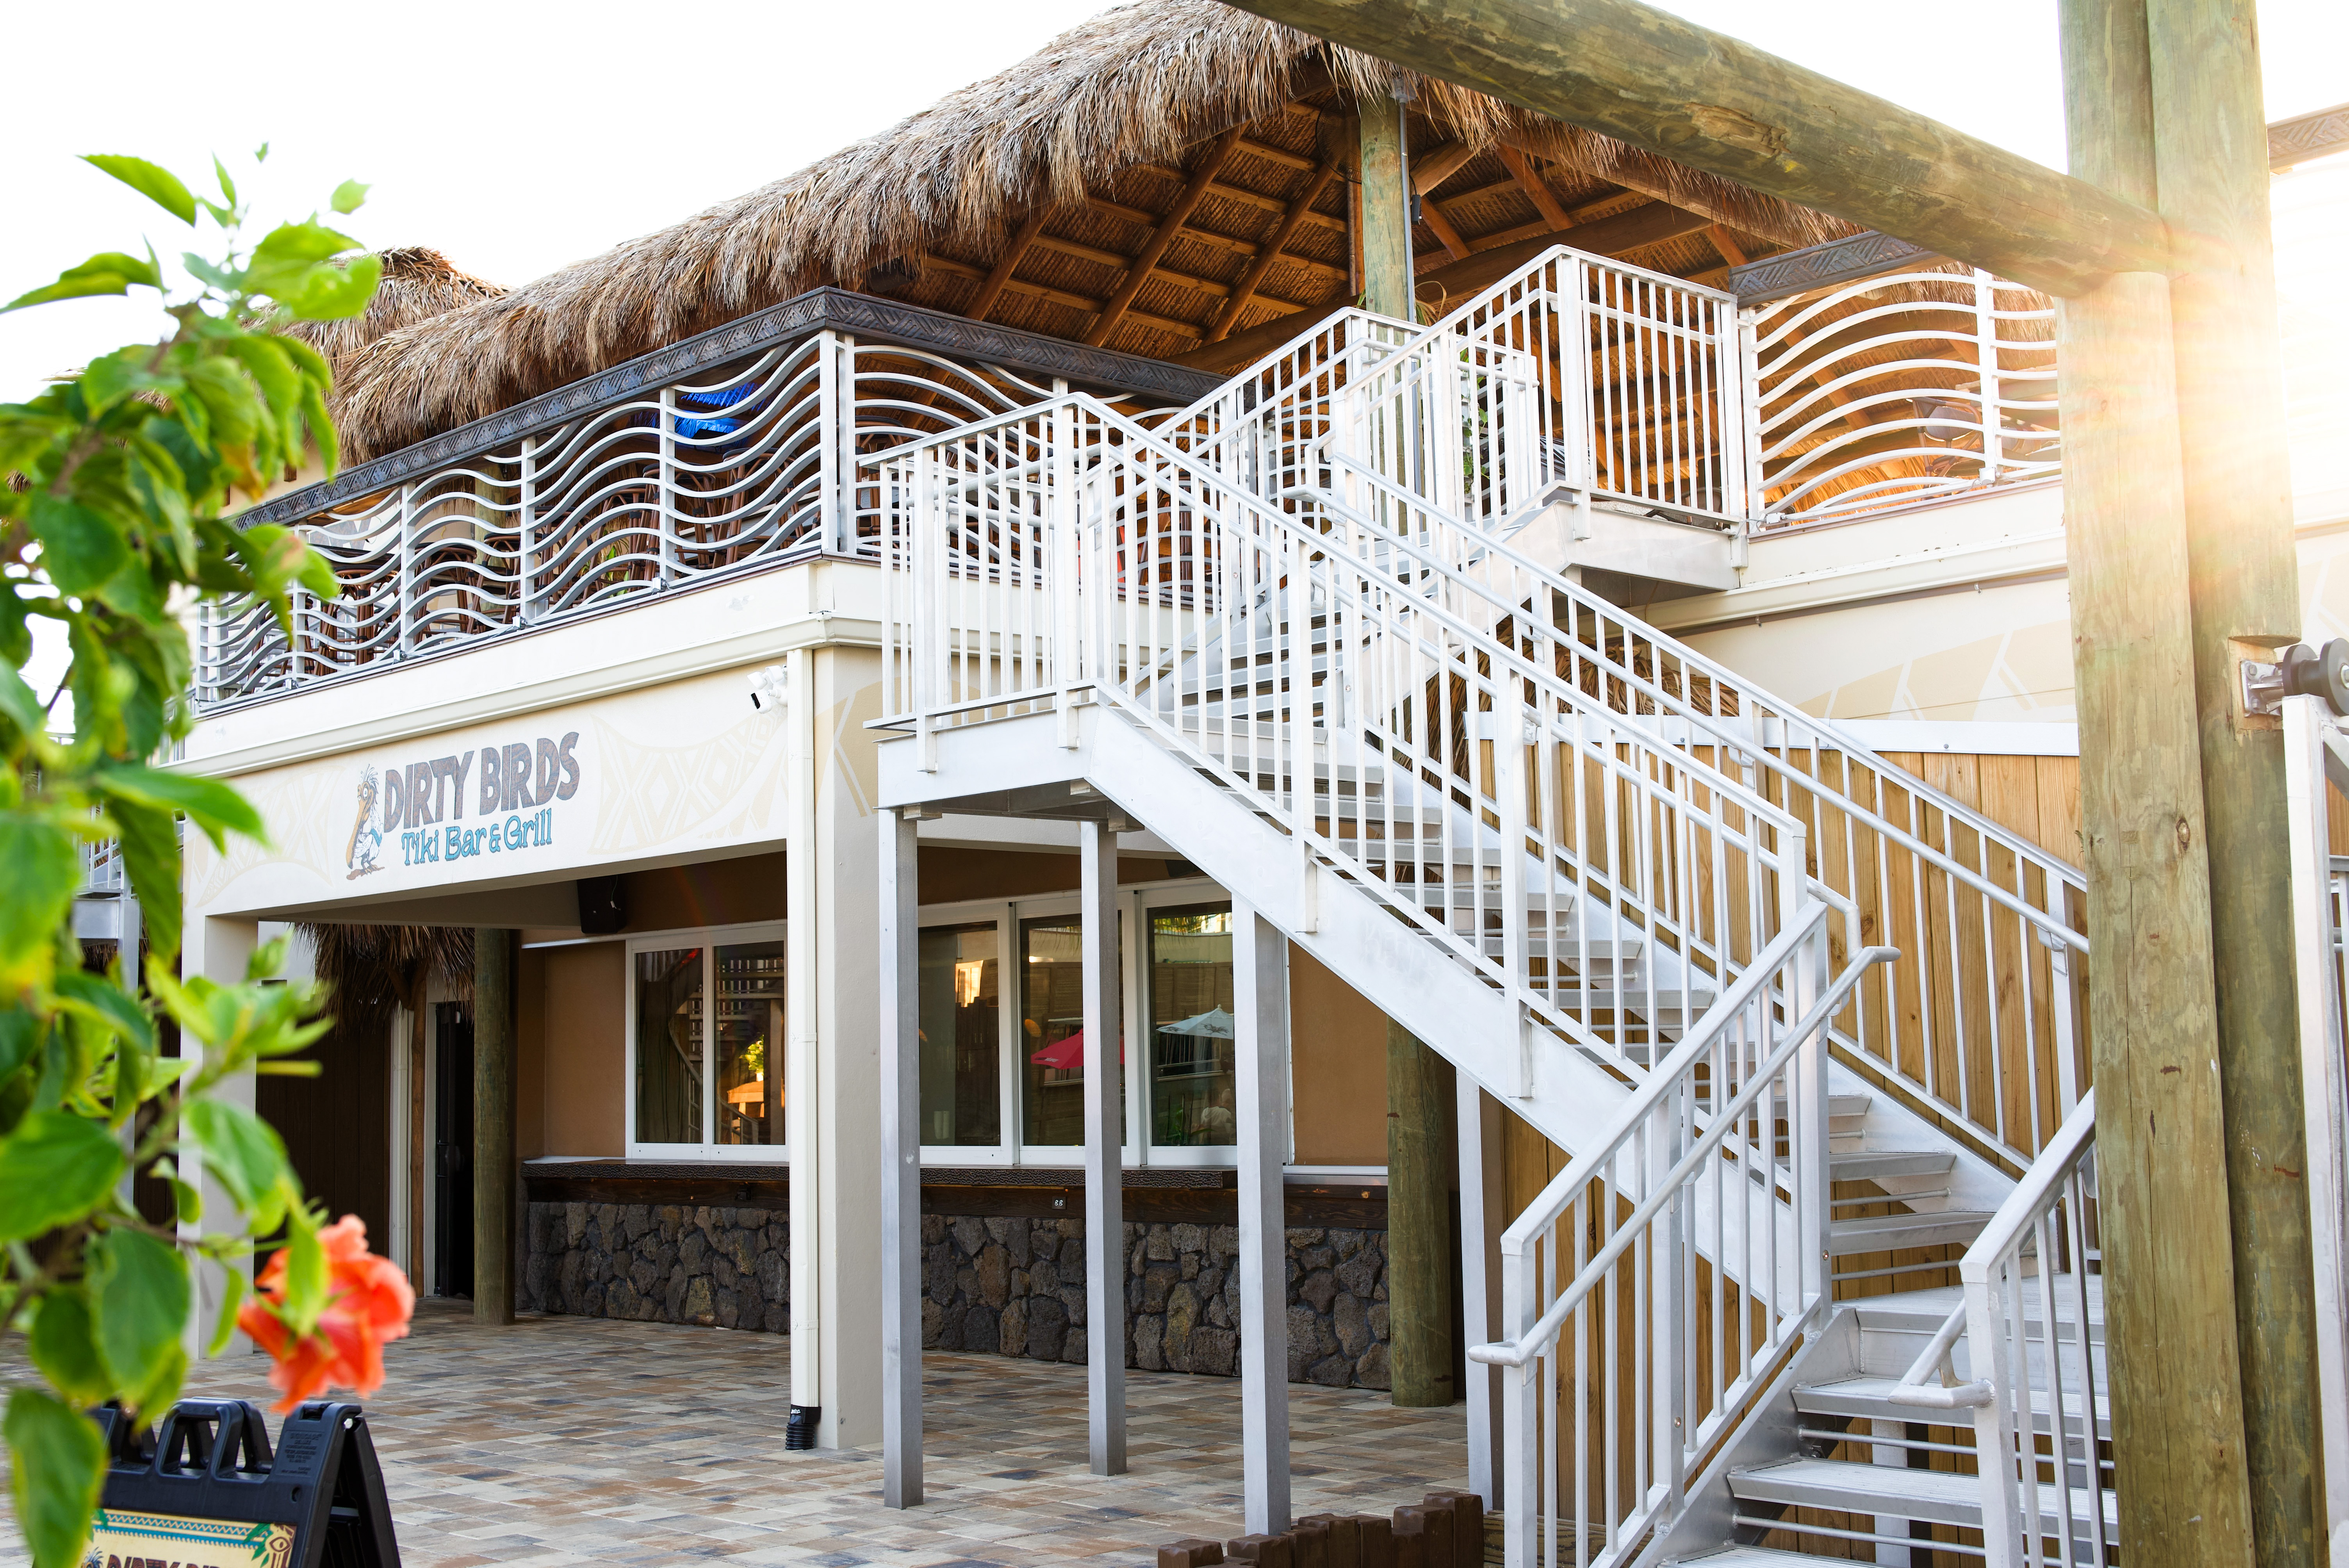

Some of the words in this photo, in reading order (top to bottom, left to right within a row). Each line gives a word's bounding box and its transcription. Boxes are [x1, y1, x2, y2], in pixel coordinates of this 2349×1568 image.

[384, 750, 475, 833] DIRTY
[479, 732, 580, 816] BIRDS
[401, 829, 439, 866] Tiki
